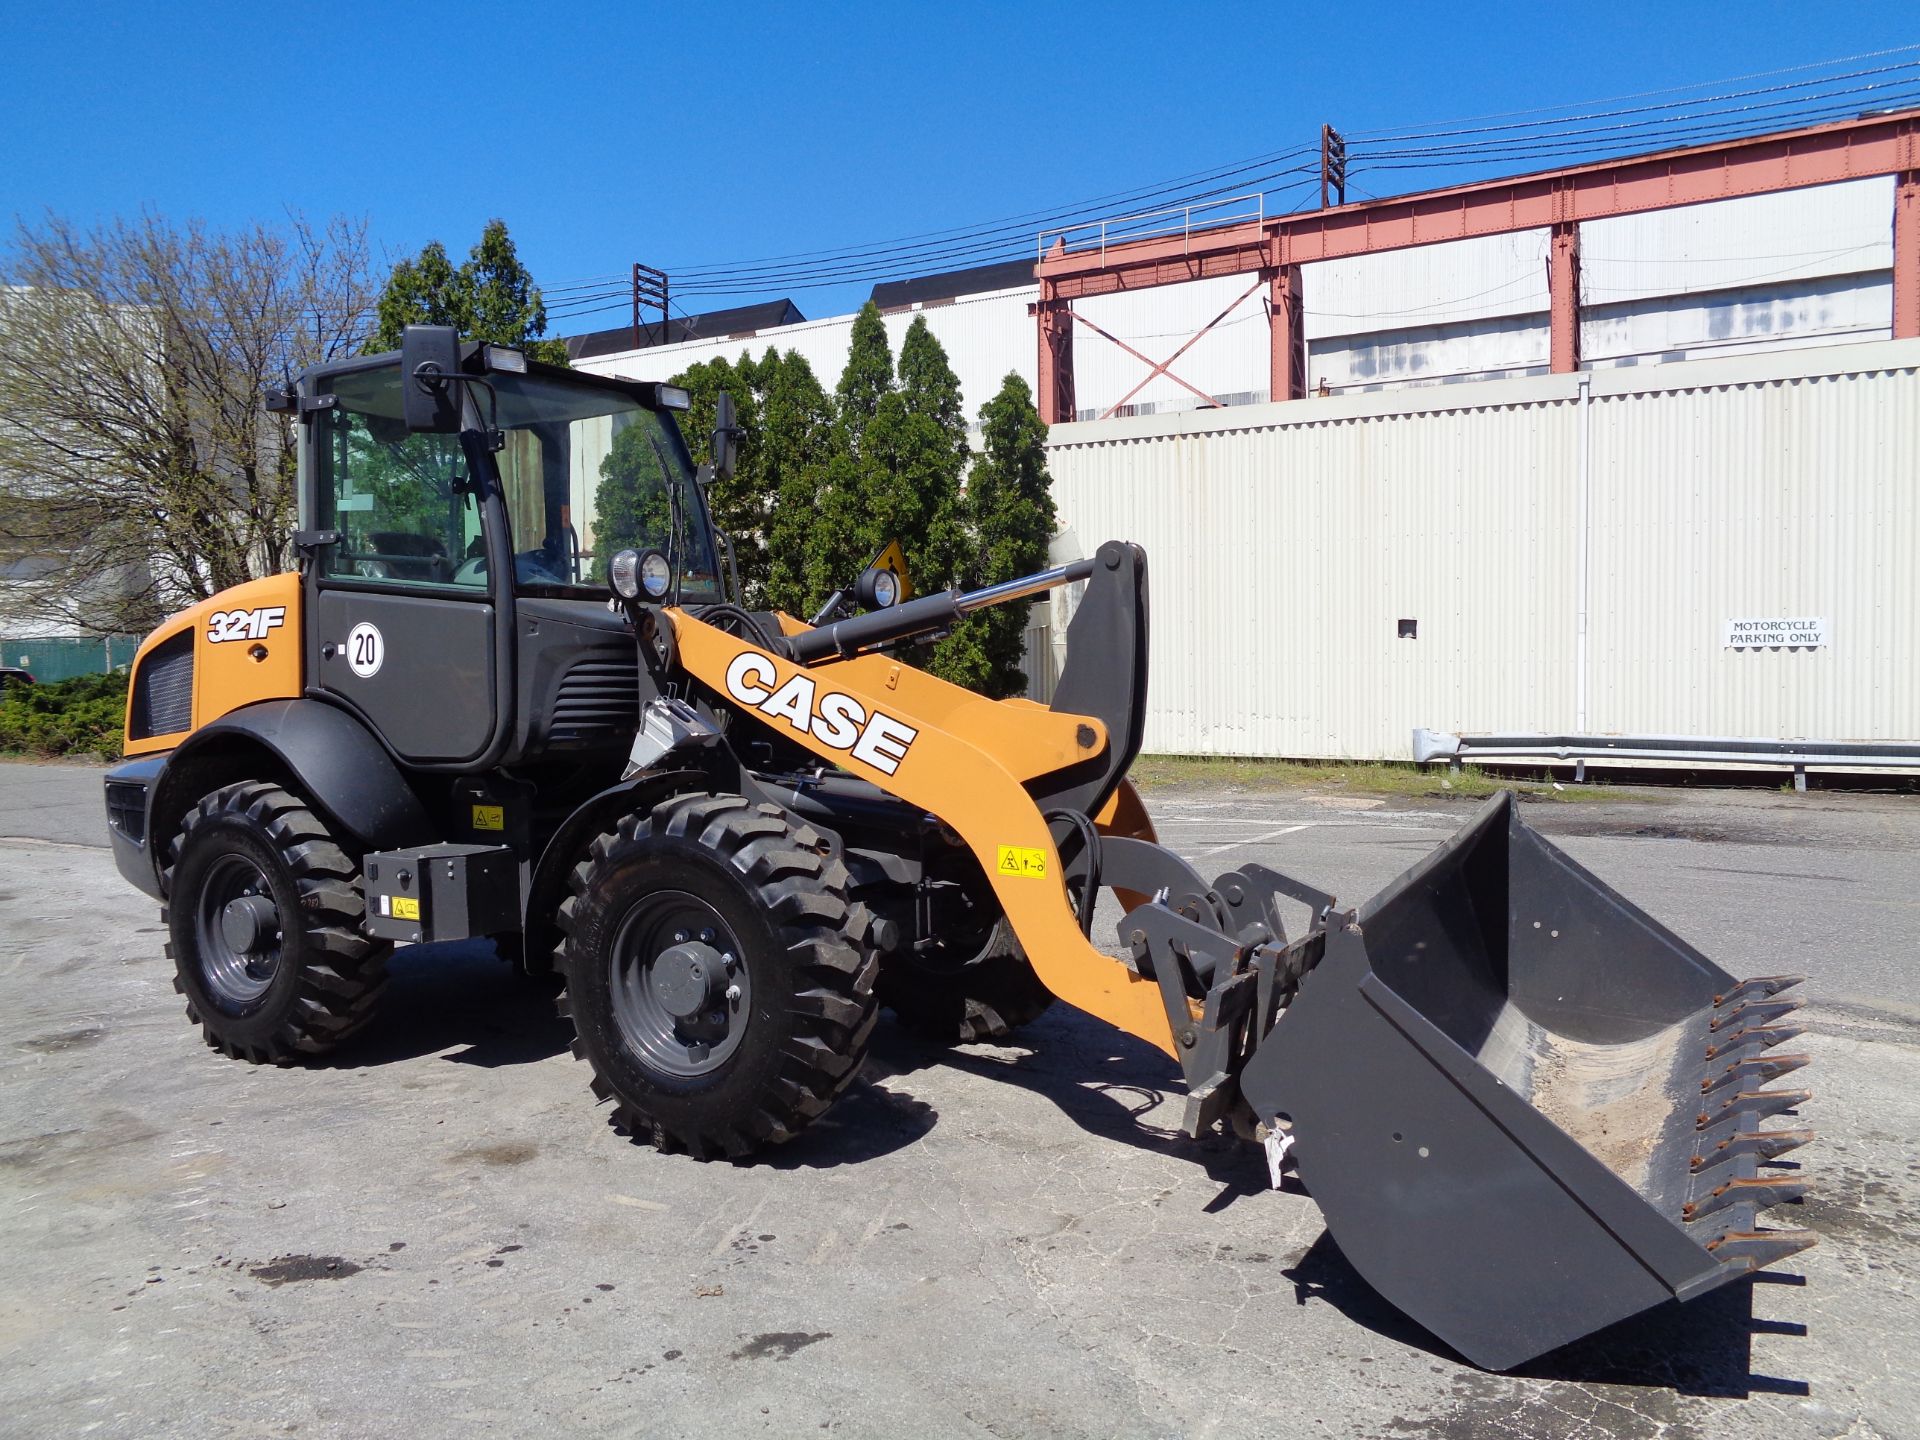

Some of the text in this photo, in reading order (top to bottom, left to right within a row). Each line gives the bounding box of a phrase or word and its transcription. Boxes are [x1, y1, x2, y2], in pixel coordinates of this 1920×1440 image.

[207, 606, 286, 643] 321F
[1730, 633, 1821, 643] PARKING ONLY
[1734, 621, 1817, 631] MOTORCYCLE
[355, 633, 375, 665] 20
[725, 651, 919, 776] CASE
